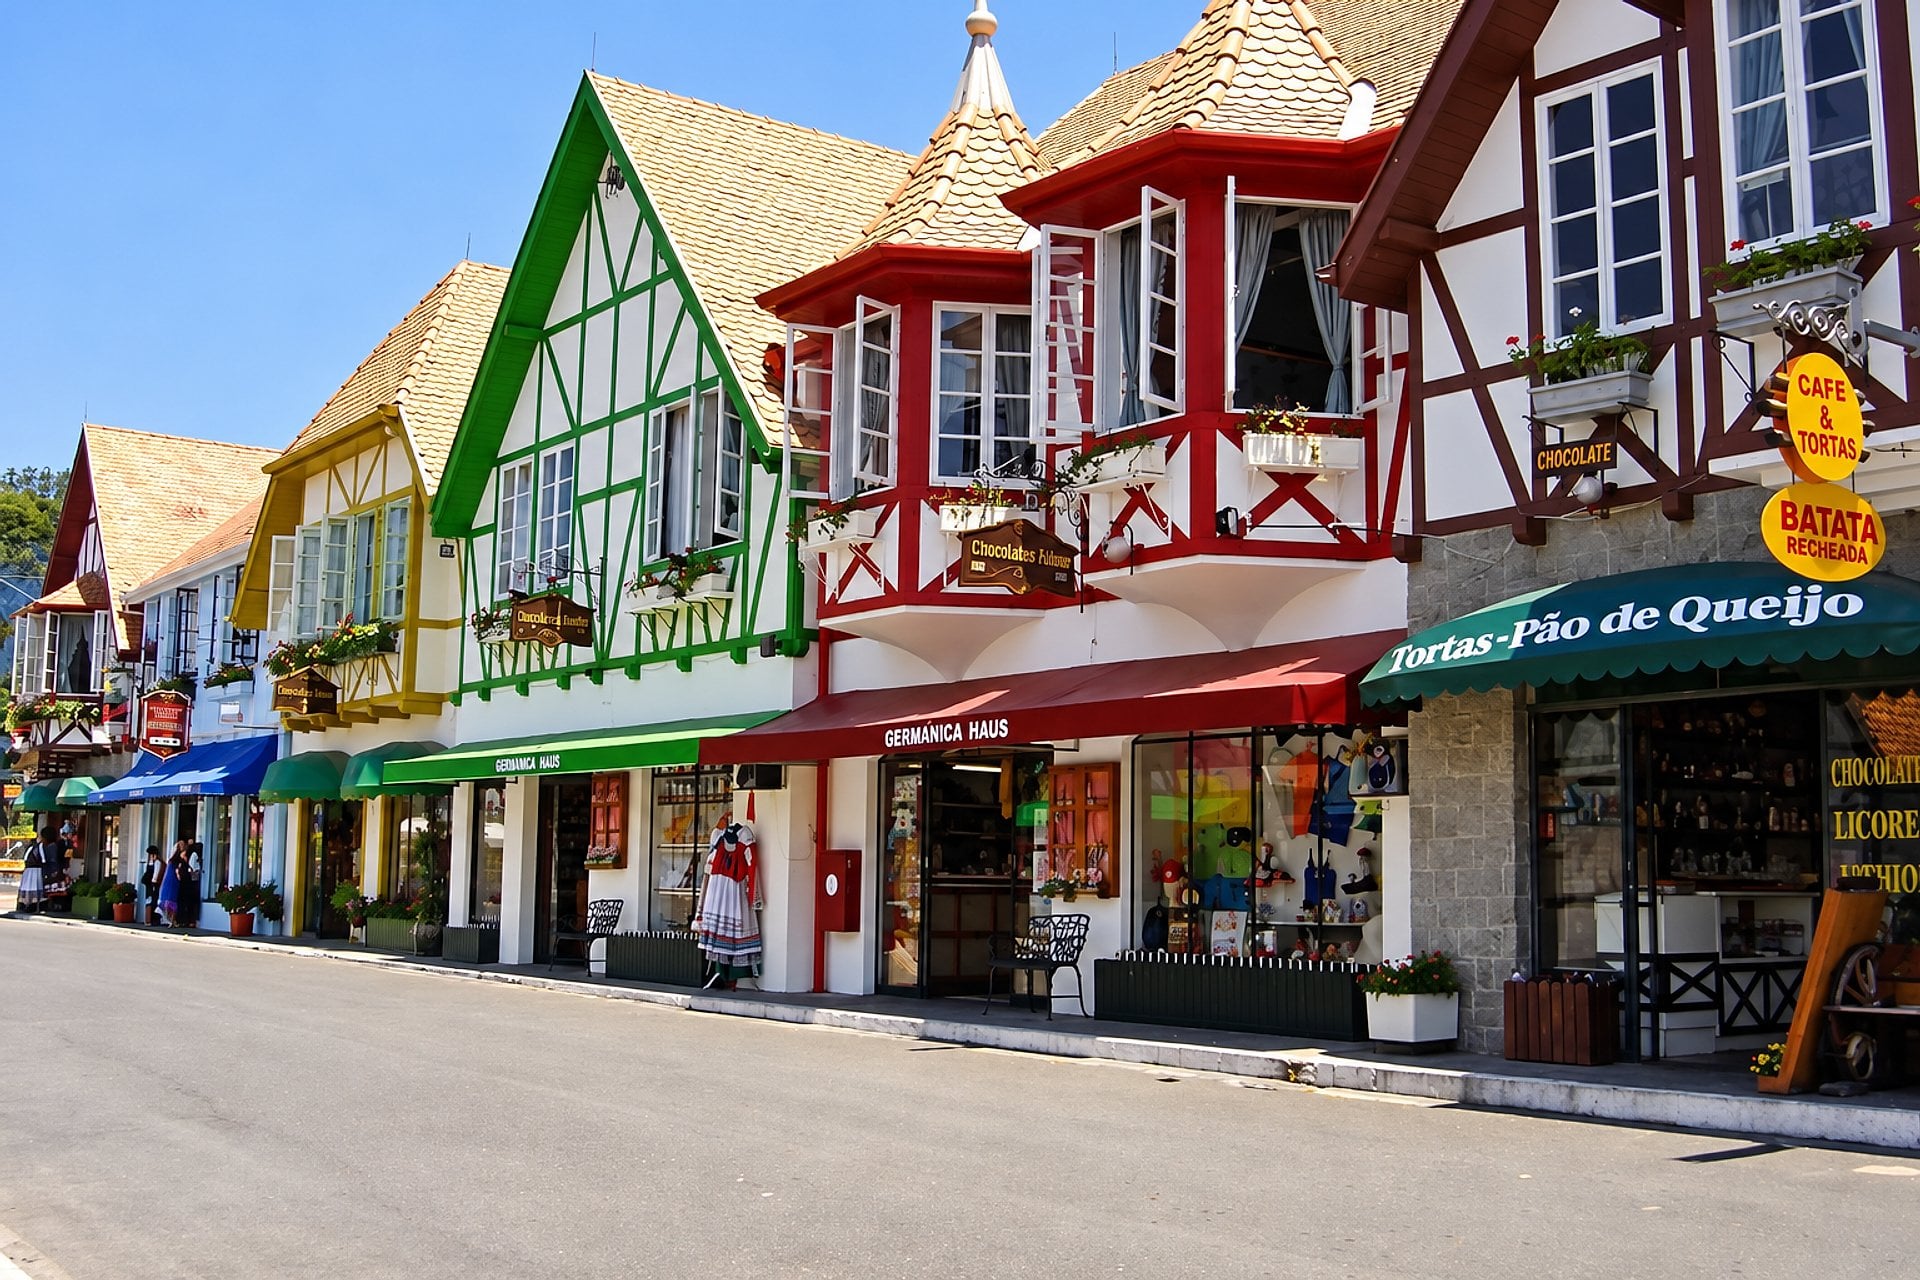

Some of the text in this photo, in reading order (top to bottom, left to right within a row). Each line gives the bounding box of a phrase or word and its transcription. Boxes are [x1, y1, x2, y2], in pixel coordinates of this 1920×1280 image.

[1797, 373, 1847, 402] CAFE
[1819, 405, 1834, 430] &
[1537, 442, 1612, 470] CHOCOLATE
[1797, 430, 1857, 460] TORTAS
[1780, 500, 1879, 545] BATATA
[971, 539, 1036, 564] Chocolates
[1786, 535, 1868, 565] RECHEADA
[1599, 602, 1661, 634] de
[1668, 584, 1864, 633] Queijo
[968, 718, 1009, 740] HAUS
